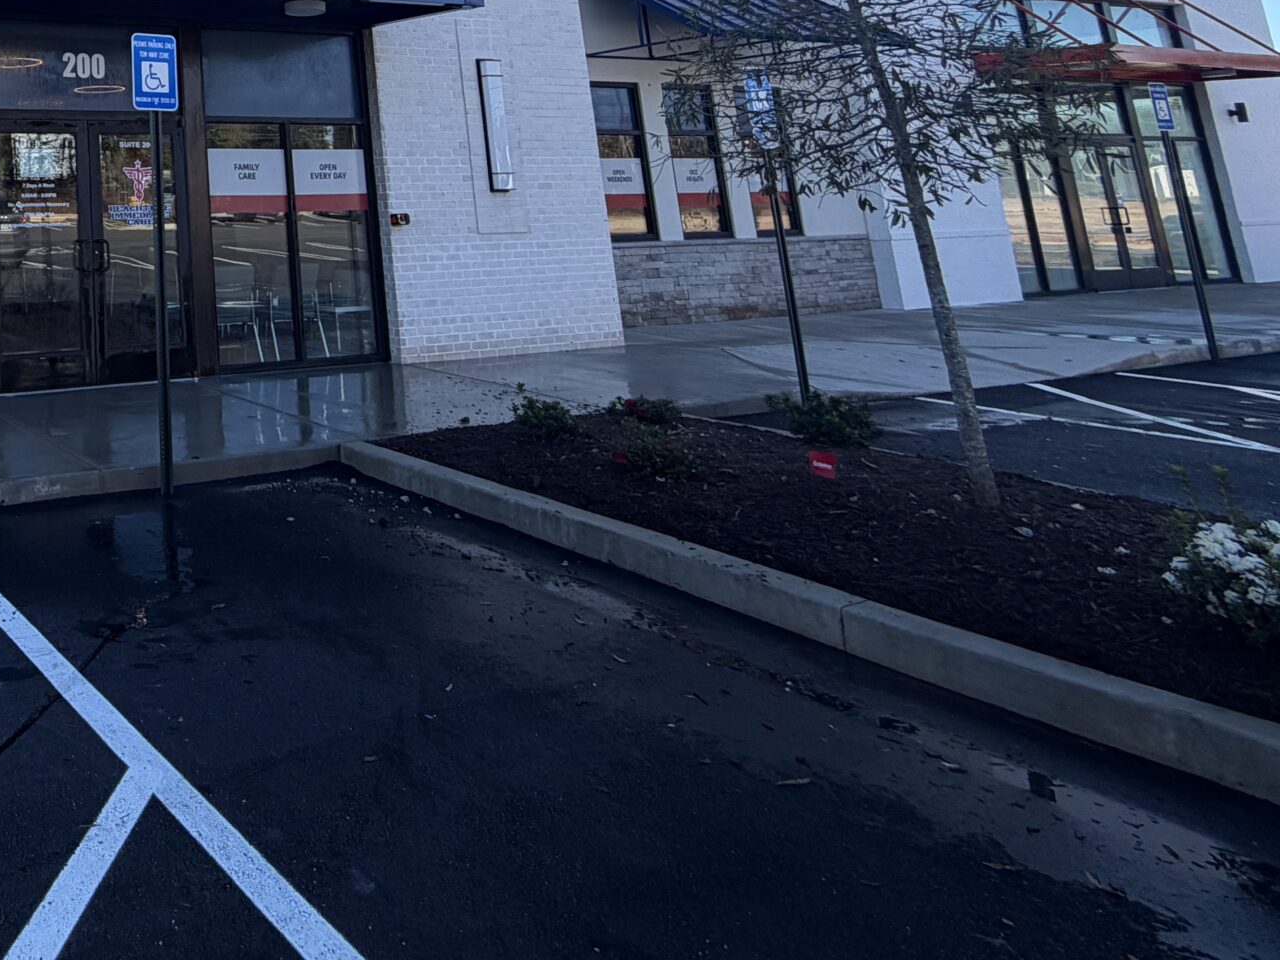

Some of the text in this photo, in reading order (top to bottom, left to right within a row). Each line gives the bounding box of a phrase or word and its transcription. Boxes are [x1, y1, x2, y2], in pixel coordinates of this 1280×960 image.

[62, 52, 106, 79] 200
[234, 163, 259, 171] FAMILY
[319, 163, 337, 171] OPEN
[238, 172, 256, 180] CARE
[310, 172, 331, 180] EVERY
